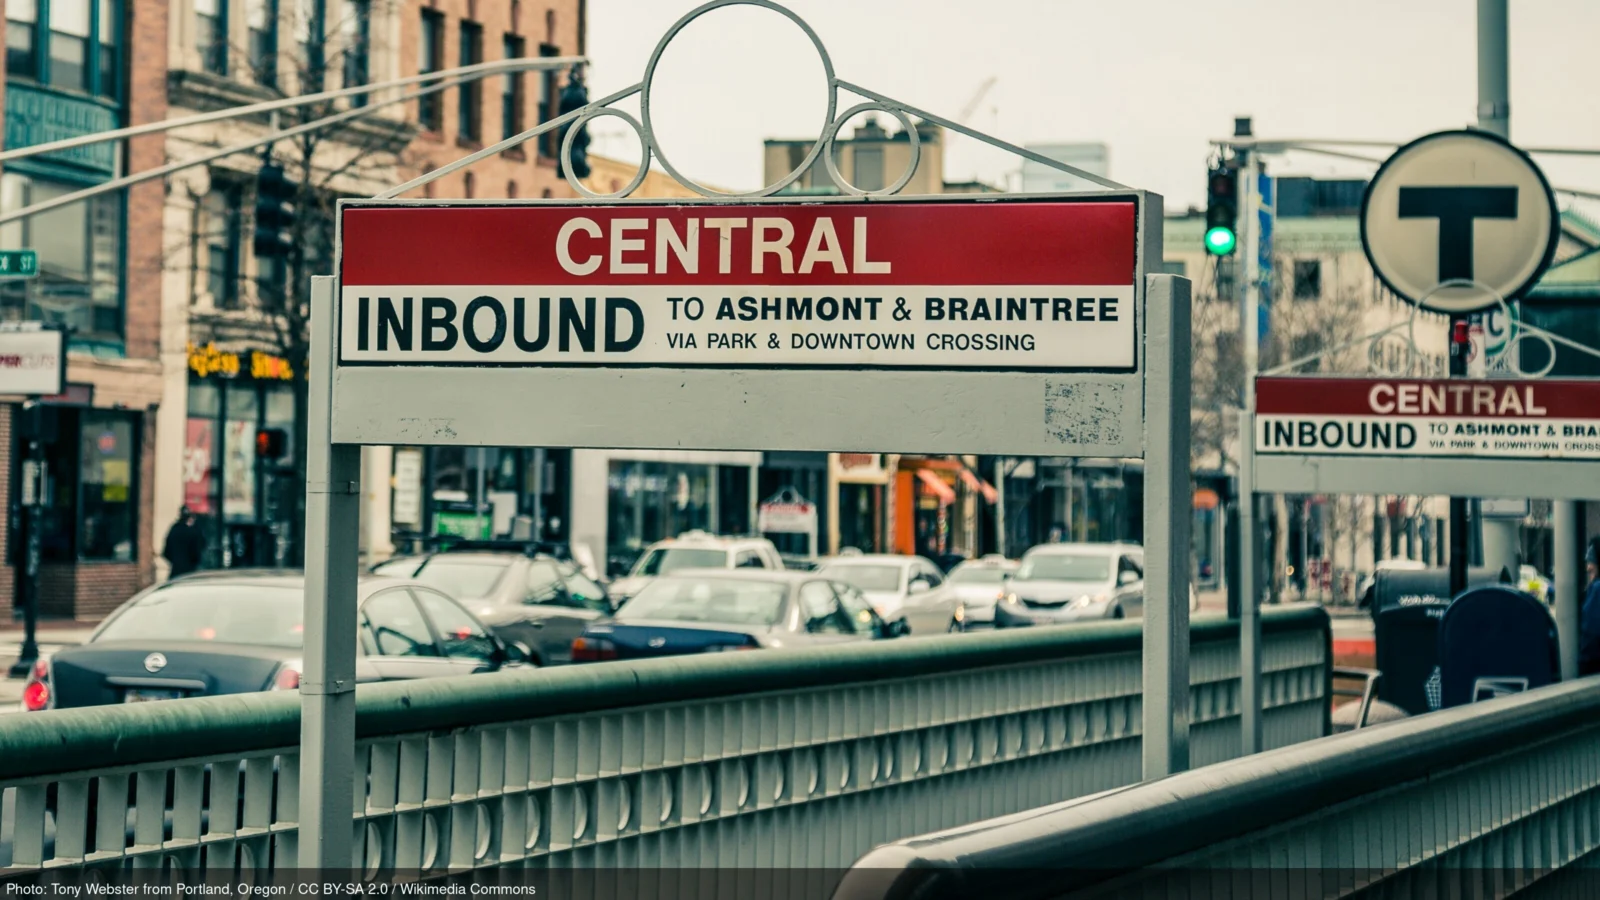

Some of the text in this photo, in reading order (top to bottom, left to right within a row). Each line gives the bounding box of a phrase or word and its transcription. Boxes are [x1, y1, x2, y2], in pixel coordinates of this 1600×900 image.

[555, 216, 892, 276] CENTRAL
[1398, 186, 1519, 288] T
[666, 296, 1119, 323] TO ASHMONT & BRAINTREE
[357, 295, 645, 354] INBOUND
[666, 332, 1035, 352] VIA PARK & DOWNTOWN CROSSING
[1368, 383, 1547, 416] CENTRAL
[1264, 420, 1417, 449] INBOUND
[1430, 422, 1449, 435] TO
[1454, 423, 1541, 436] ASHMONT
[1546, 424, 1556, 436] &
[1429, 440, 1445, 448] VIA
[1450, 440, 1476, 449] PARK
[1494, 441, 1559, 450] DOWNTOWN
